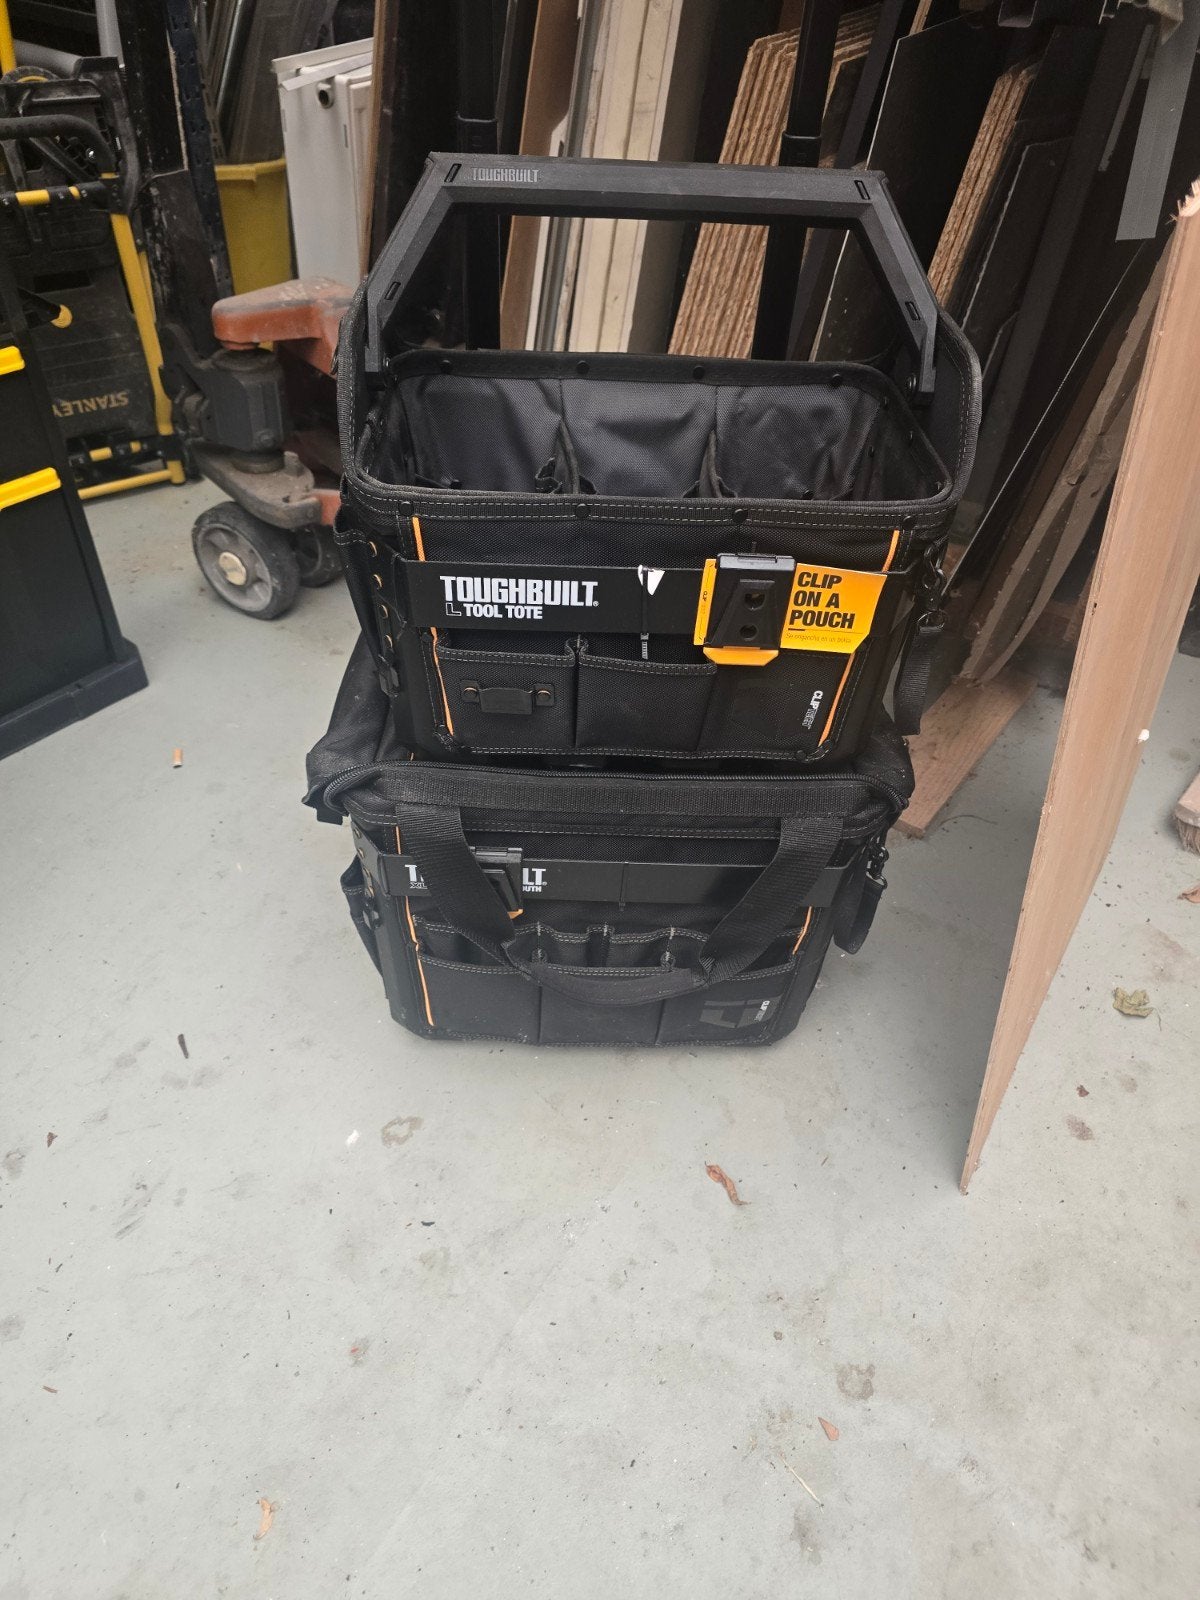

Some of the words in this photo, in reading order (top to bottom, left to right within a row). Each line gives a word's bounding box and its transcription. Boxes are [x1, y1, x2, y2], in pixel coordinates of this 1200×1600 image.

[471, 167, 540, 183] TOUGHBUILT
[52, 391, 130, 418] STANLEY
[796, 571, 843, 589] CLIP
[793, 590, 820, 609] ON
[825, 592, 841, 609] A
[463, 603, 503, 618] TOOL
[505, 604, 543, 620] TOTE
[788, 609, 856, 630] POUCH
